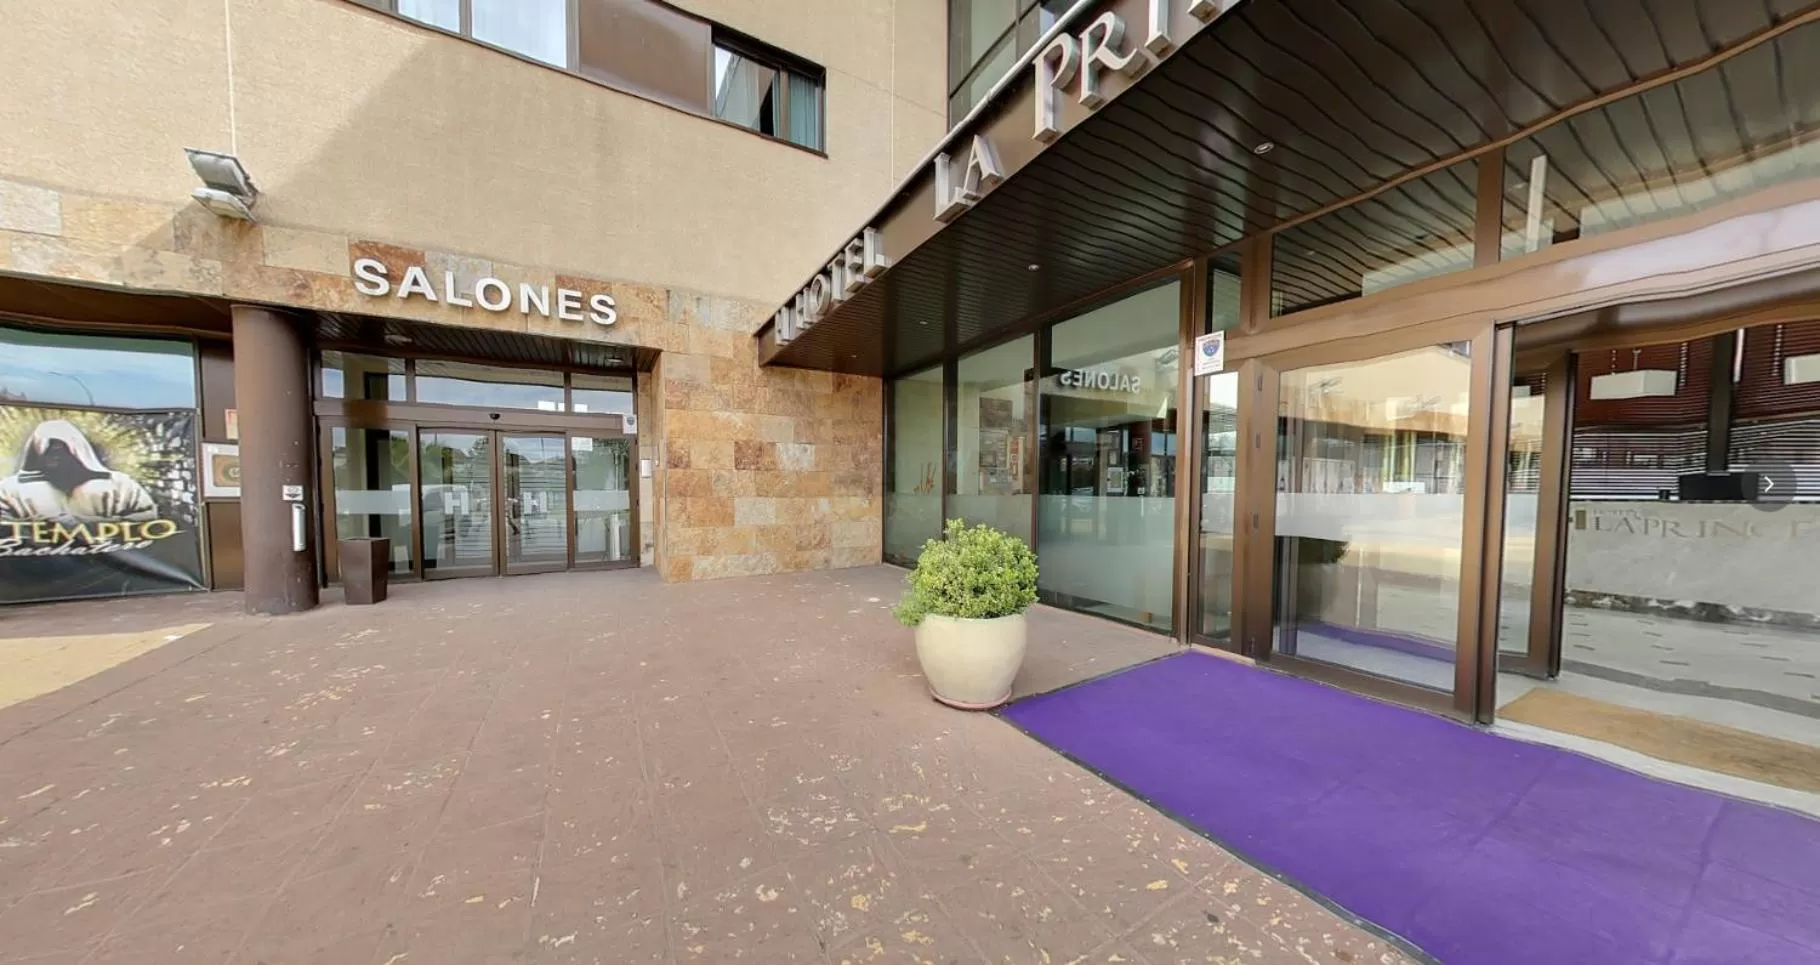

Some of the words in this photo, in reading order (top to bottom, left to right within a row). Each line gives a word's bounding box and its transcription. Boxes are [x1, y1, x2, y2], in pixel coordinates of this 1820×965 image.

[796, 226, 889, 330] HOTEL
[933, 134, 1003, 222] LA
[353, 258, 618, 326] SALONES
[1, 518, 187, 545] TEMPLO
